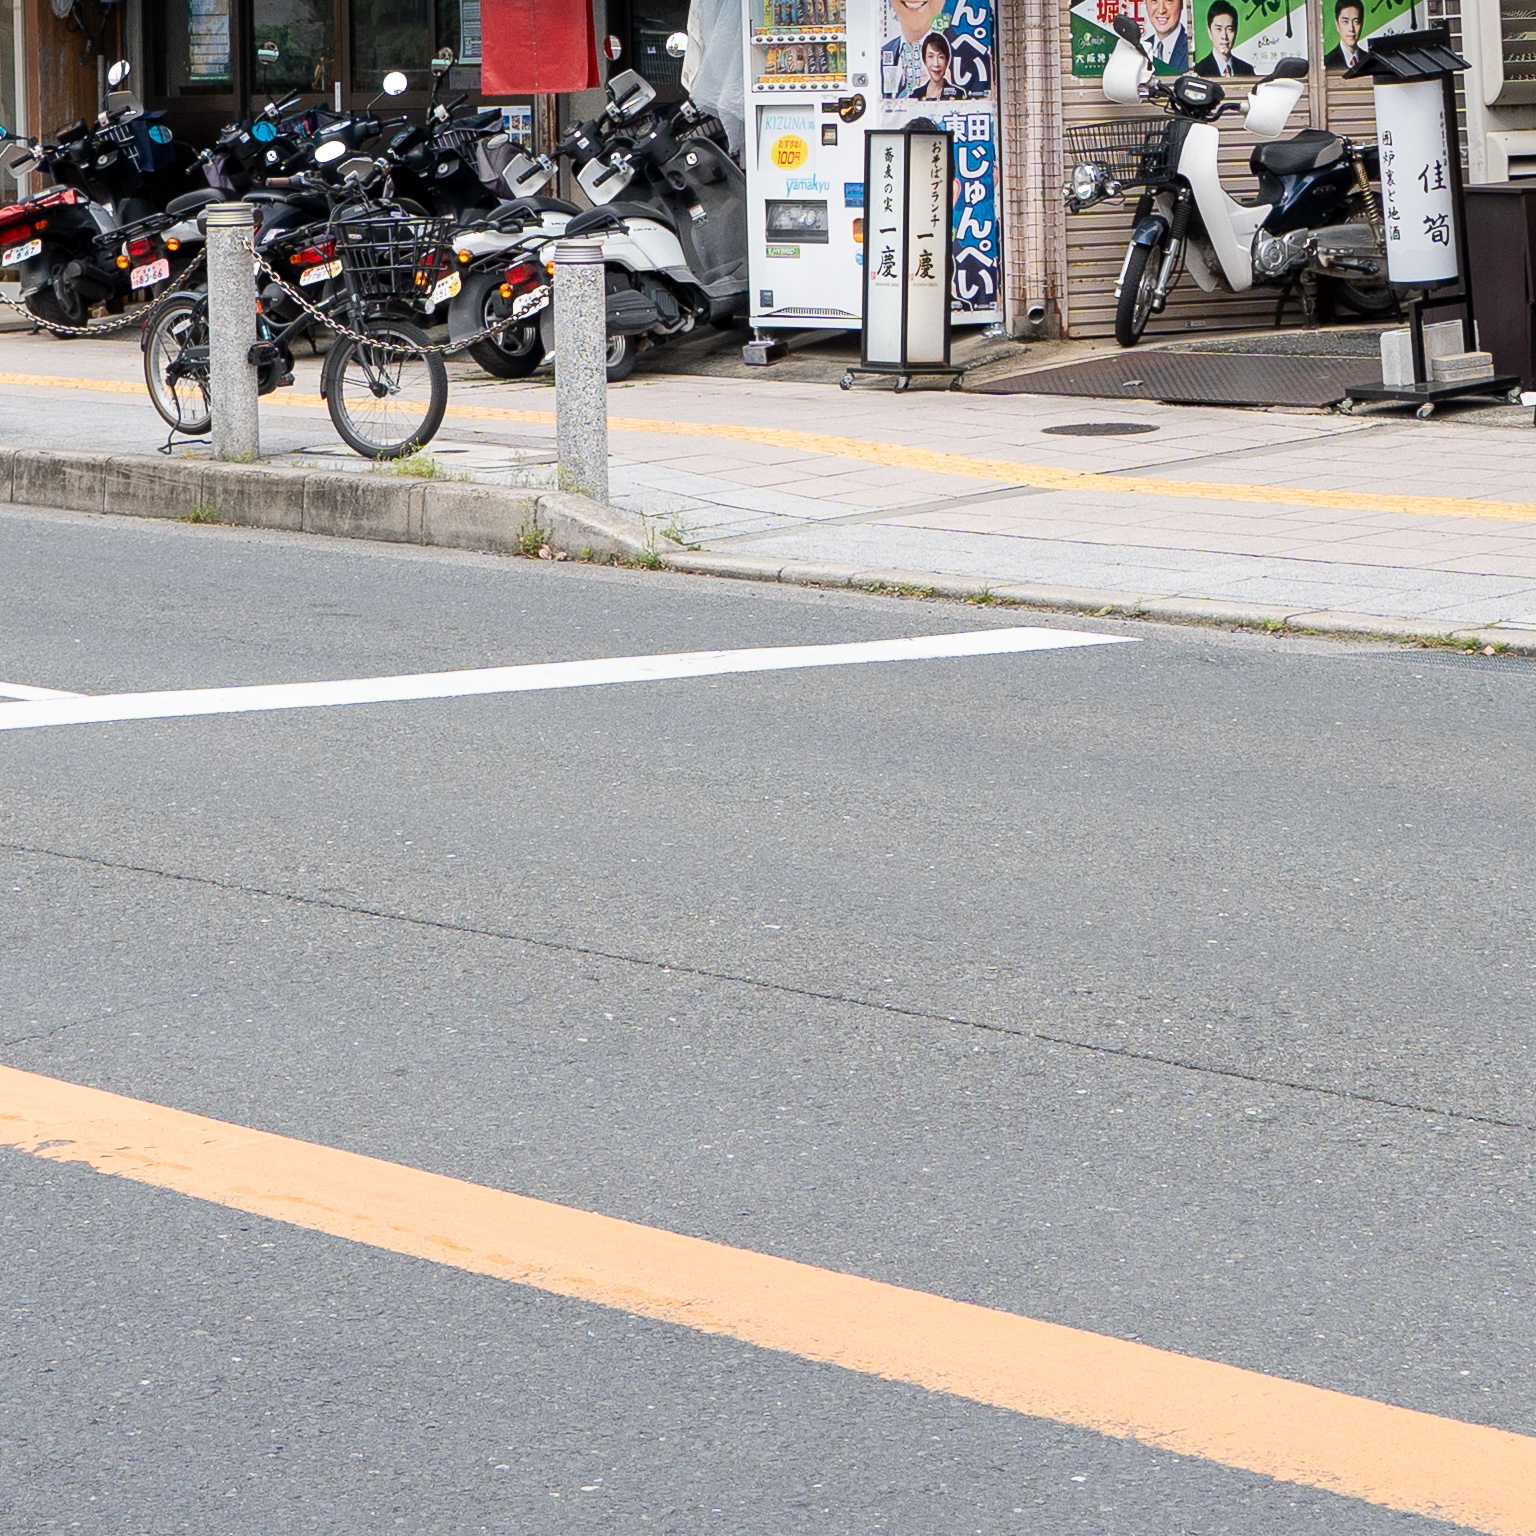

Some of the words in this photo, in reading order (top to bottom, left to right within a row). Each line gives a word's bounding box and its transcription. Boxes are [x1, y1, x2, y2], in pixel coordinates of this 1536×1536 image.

[955, 146, 994, 300] じゅんぺい
